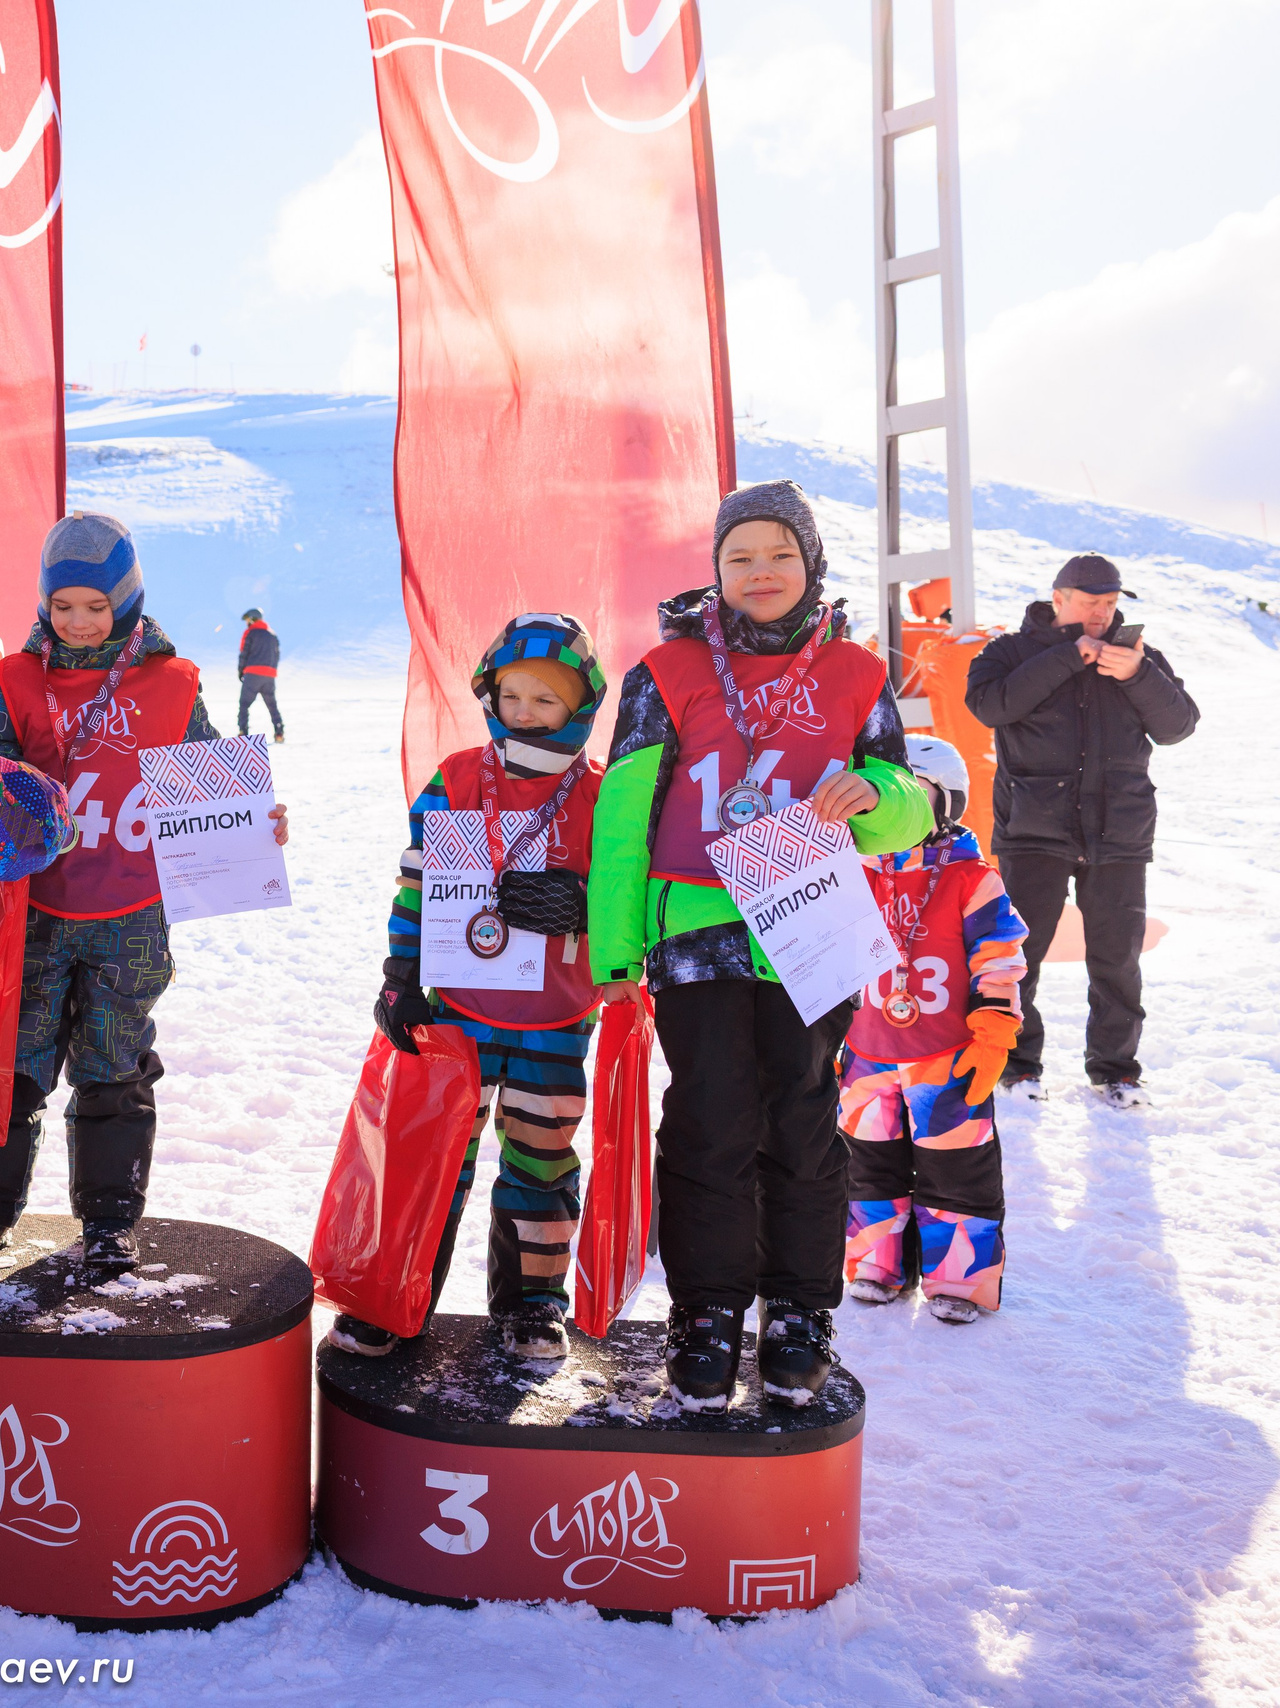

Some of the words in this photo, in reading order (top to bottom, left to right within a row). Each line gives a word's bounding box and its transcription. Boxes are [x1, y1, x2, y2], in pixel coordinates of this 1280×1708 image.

[154, 811, 175, 820] IGORA
[175, 809, 189, 817] CUP
[158, 809, 253, 840] ДИПЛОМ
[161, 851, 196, 860] НАГРАЖДАЕТСЯ
[746, 899, 765, 915] IGORA
[763, 893, 775, 906] CUP
[754, 871, 840, 936] ДИПЛОМ
[419, 1467, 491, 1555] 3
